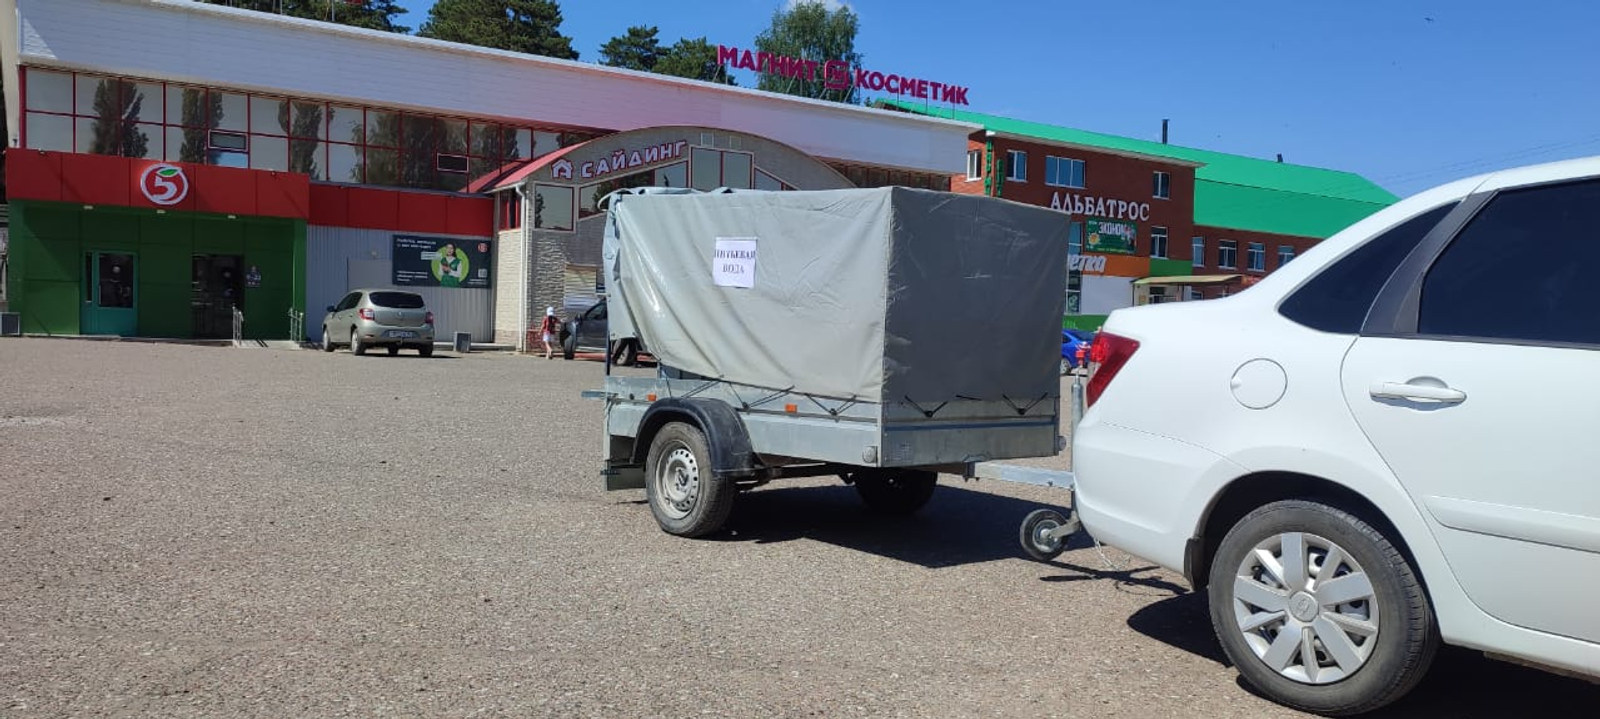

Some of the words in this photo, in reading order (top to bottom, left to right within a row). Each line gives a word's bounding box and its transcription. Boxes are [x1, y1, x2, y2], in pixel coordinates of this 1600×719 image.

[717, 45, 818, 81] МАГНИТ
[855, 68, 970, 105] КОСМЕТИК
[581, 140, 687, 178] САЙДИНГ
[1051, 191, 1150, 221] АЛЬБАТРОС
[714, 250, 756, 259] ПИТЬЕВАЯ
[1067, 255, 1106, 273] етка
[722, 264, 745, 274] ВОДА
